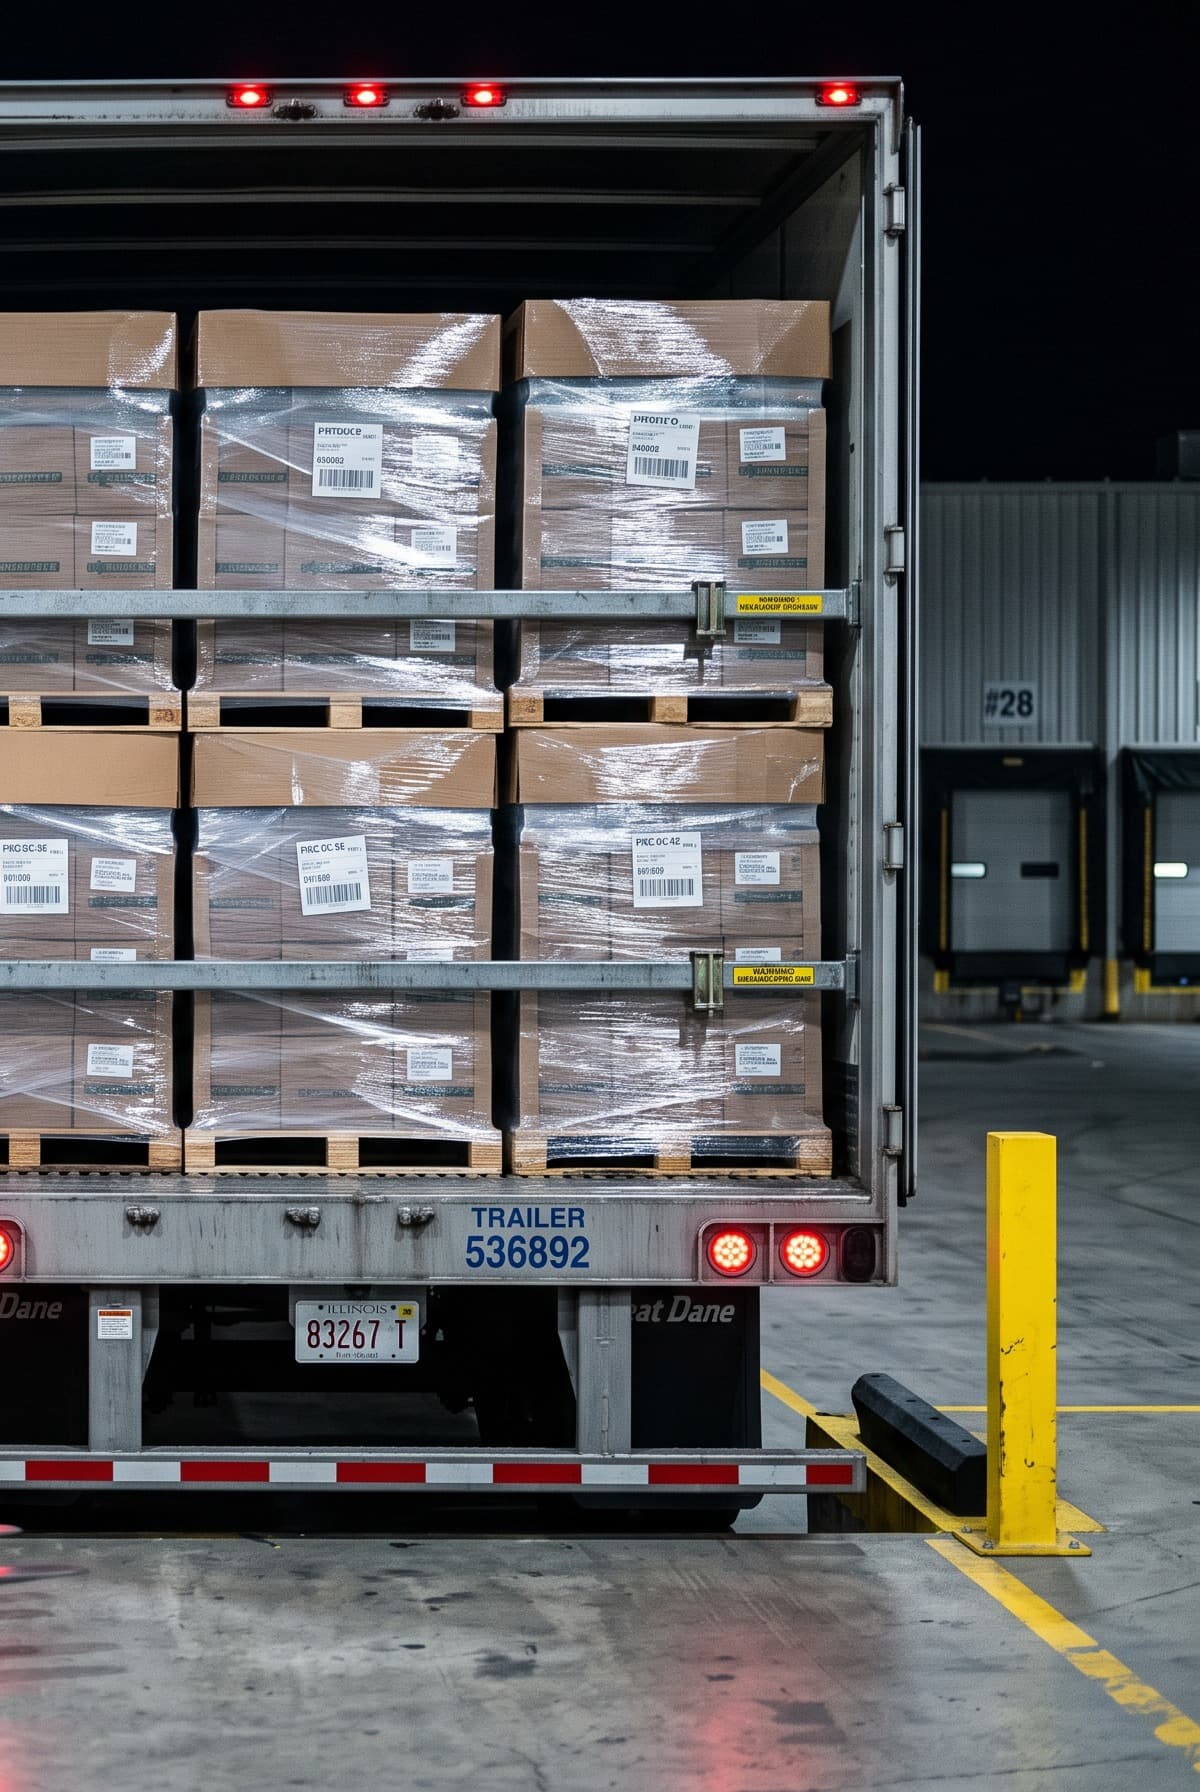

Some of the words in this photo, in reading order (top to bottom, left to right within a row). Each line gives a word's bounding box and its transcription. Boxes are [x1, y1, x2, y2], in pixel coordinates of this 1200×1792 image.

[985, 688, 1034, 718] #28
[471, 1207, 585, 1228] TRAILER
[465, 1235, 590, 1269] 536892
[327, 1304, 388, 1315] ILLINOIS
[631, 1299, 665, 1323] at
[666, 1295, 736, 1323] Dane
[307, 1319, 381, 1349] 83267
[394, 1319, 407, 1349] T
